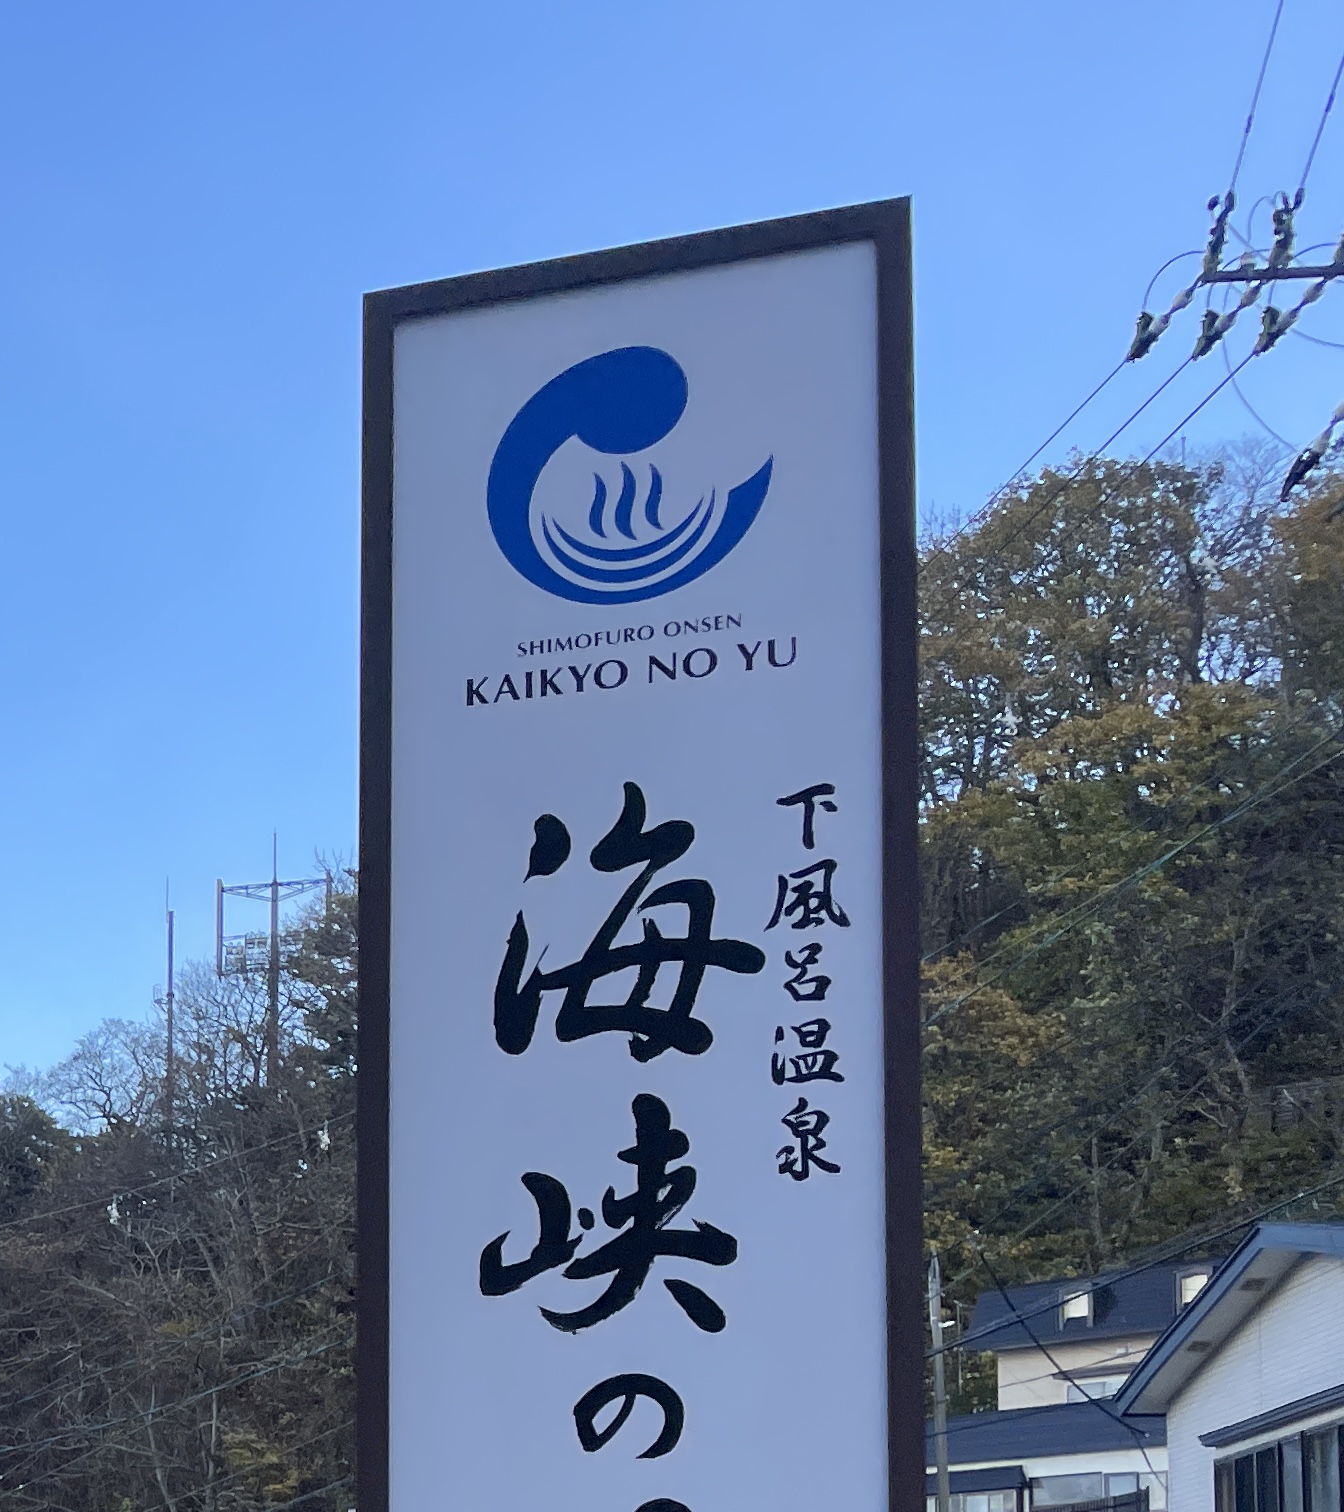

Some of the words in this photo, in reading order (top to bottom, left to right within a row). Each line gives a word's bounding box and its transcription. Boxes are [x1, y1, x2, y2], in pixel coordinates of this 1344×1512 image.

[517, 624, 655, 658] SHIMOFURO
[663, 612, 743, 638] ONSEN
[466, 659, 630, 706] KAIKYO
[648, 647, 718, 684] NO
[737, 636, 798, 671] YU
[763, 782, 852, 1183] 下風呂温泉
